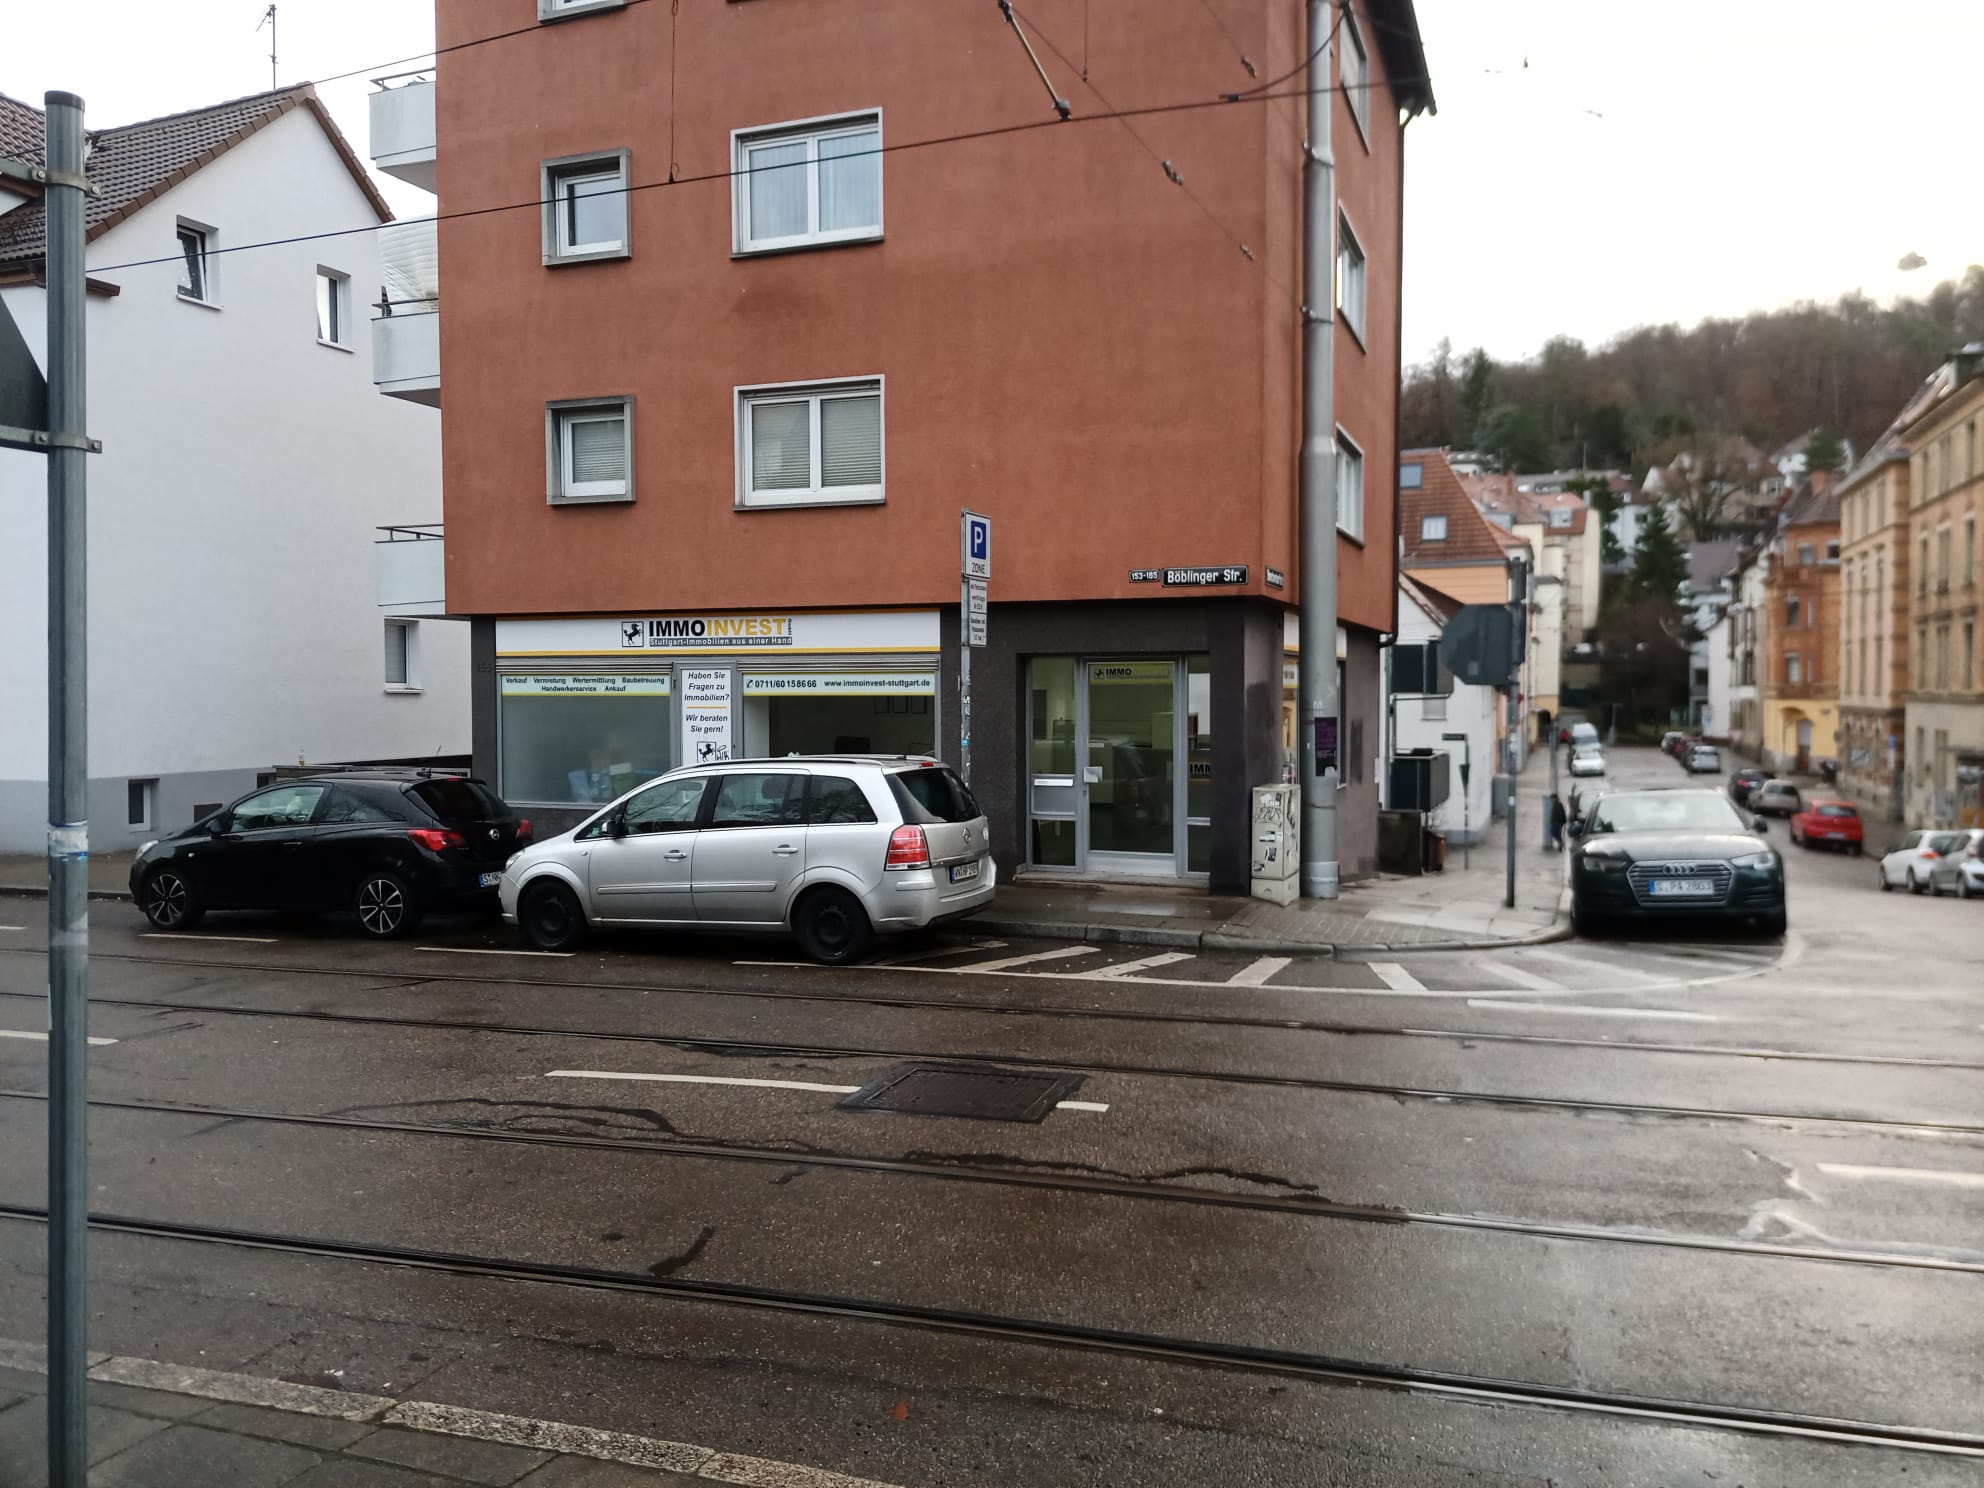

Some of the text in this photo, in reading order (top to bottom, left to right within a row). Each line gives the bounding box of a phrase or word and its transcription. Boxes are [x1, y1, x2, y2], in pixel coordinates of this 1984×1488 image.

[974, 526, 983, 553] P
[971, 562, 985, 575] ZONE
[1167, 569, 1242, 585] Böblinger Str.
[649, 618, 787, 637] IMMOINVEST
[650, 638, 730, 647] Stuttgart-Immobilien
[1105, 668, 1132, 676] IMMO
[533, 677, 566, 685] Vermietung
[824, 679, 930, 687] www.immoinvest-stuttgart.de
[688, 683, 714, 691] Fragen
[700, 714, 728, 722] beraten
[704, 725, 723, 734] gern!
